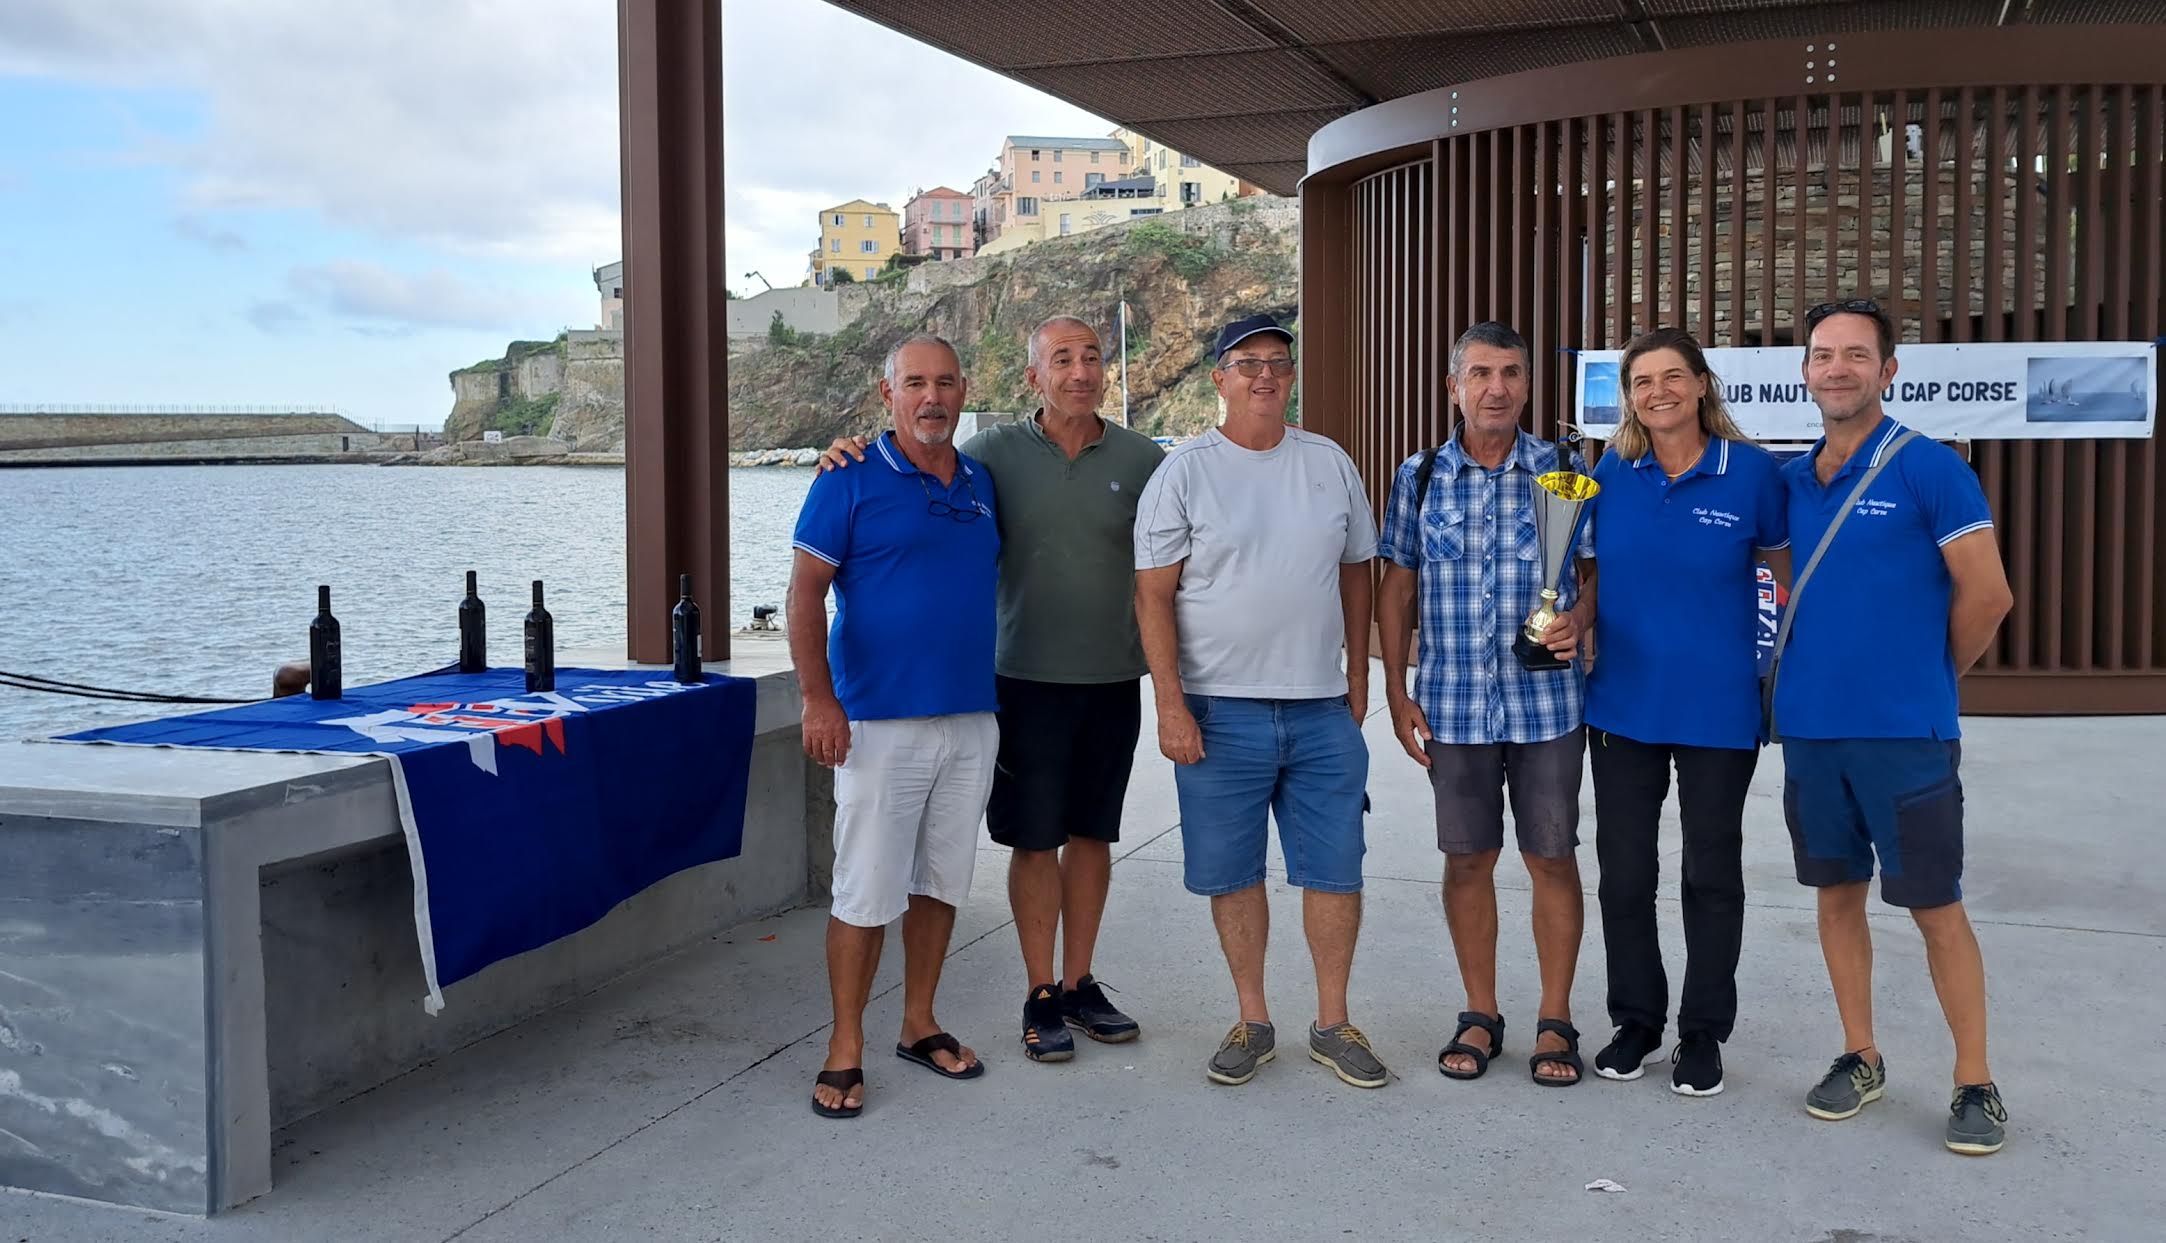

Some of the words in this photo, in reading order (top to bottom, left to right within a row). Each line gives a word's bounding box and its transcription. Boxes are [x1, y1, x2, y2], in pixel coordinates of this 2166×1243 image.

[1901, 381, 1941, 402] CAP
[1947, 381, 2018, 402] CORSE
[1692, 507, 1708, 515] Club
[1709, 509, 1740, 521] Nautique
[1856, 507, 1869, 516] Cap
[1698, 516, 1712, 526] Cap
[1713, 518, 1732, 528] Corse
